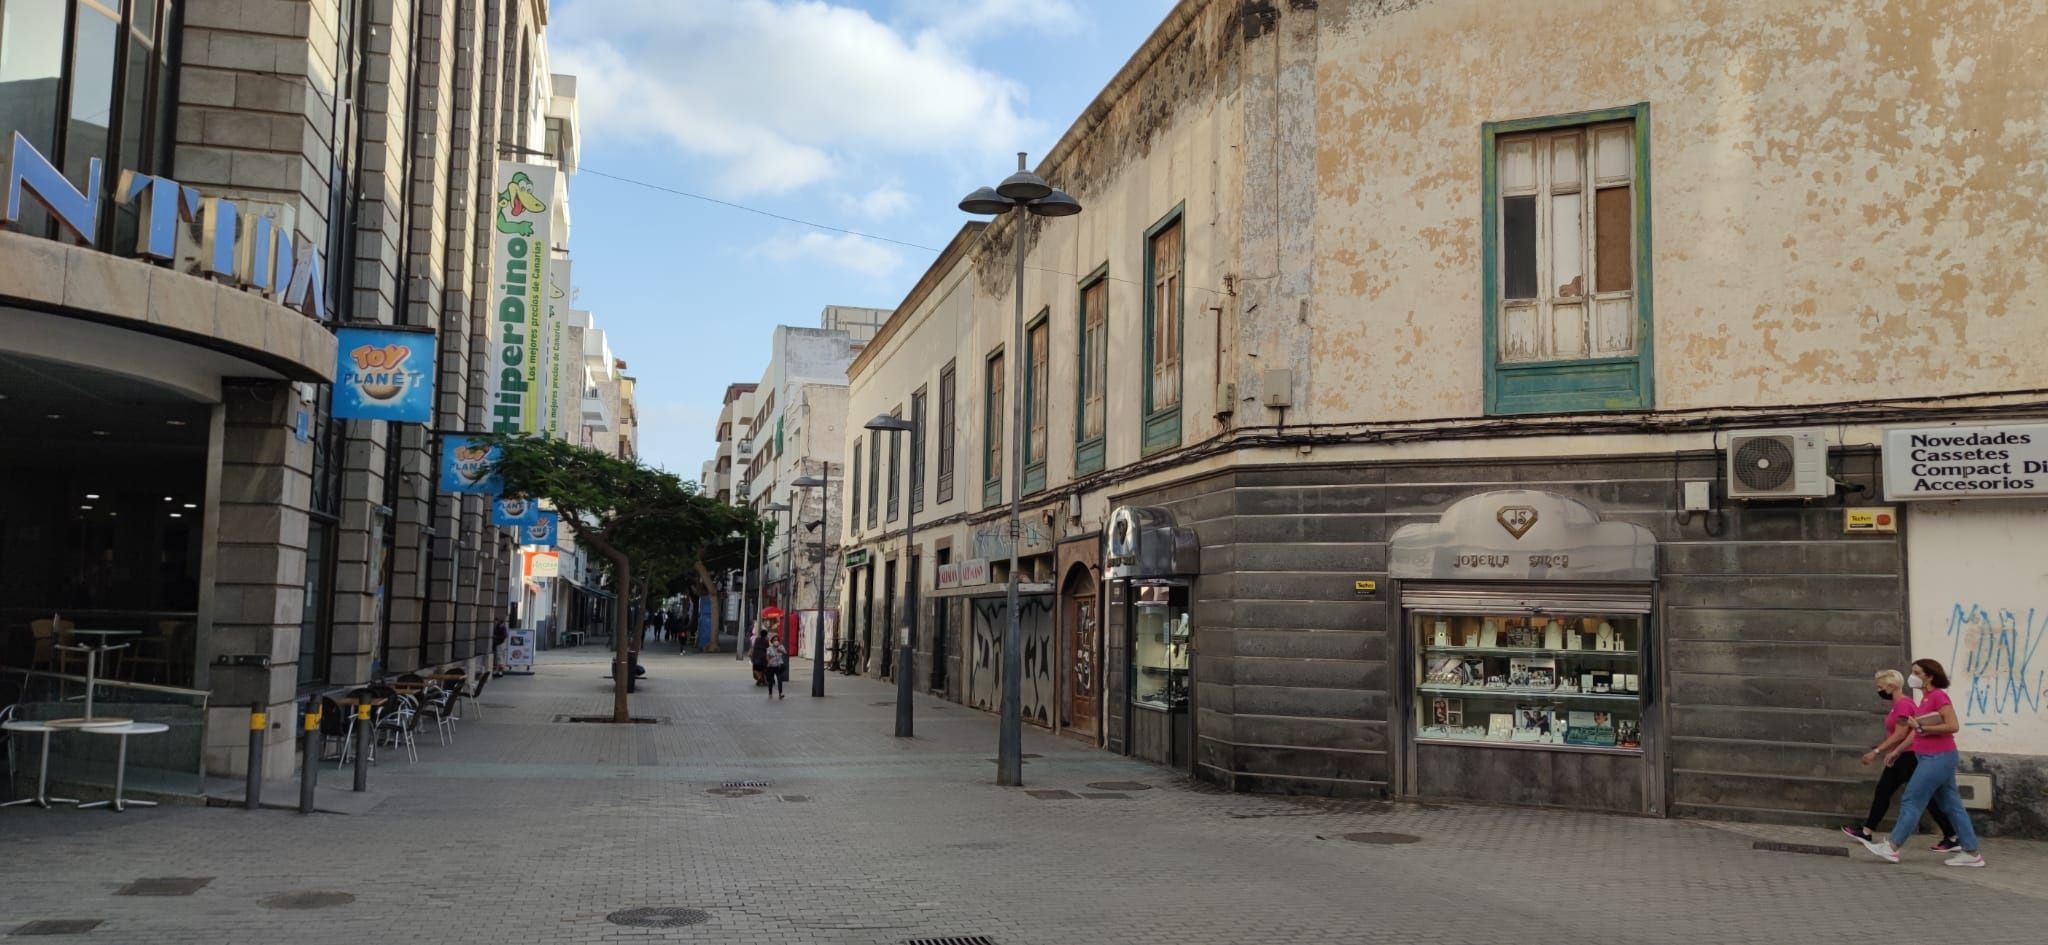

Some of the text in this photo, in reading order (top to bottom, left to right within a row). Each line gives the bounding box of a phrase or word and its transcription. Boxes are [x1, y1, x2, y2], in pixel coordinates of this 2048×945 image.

[527, 241, 542, 381] Los mejores precios de Canarias
[493, 237, 529, 433] HiperDino
[553, 321, 561, 351] Canarias
[351, 345, 410, 370] TOY
[552, 352, 560, 362] de
[344, 370, 424, 387] PLANET
[551, 363, 560, 389] precios
[550, 390, 559, 418] mejores
[1910, 432, 2031, 447] Novedades
[1910, 448, 2009, 462] Cassetes
[1911, 462, 2012, 478] Compact
[1913, 477, 2034, 491] Accesorios
